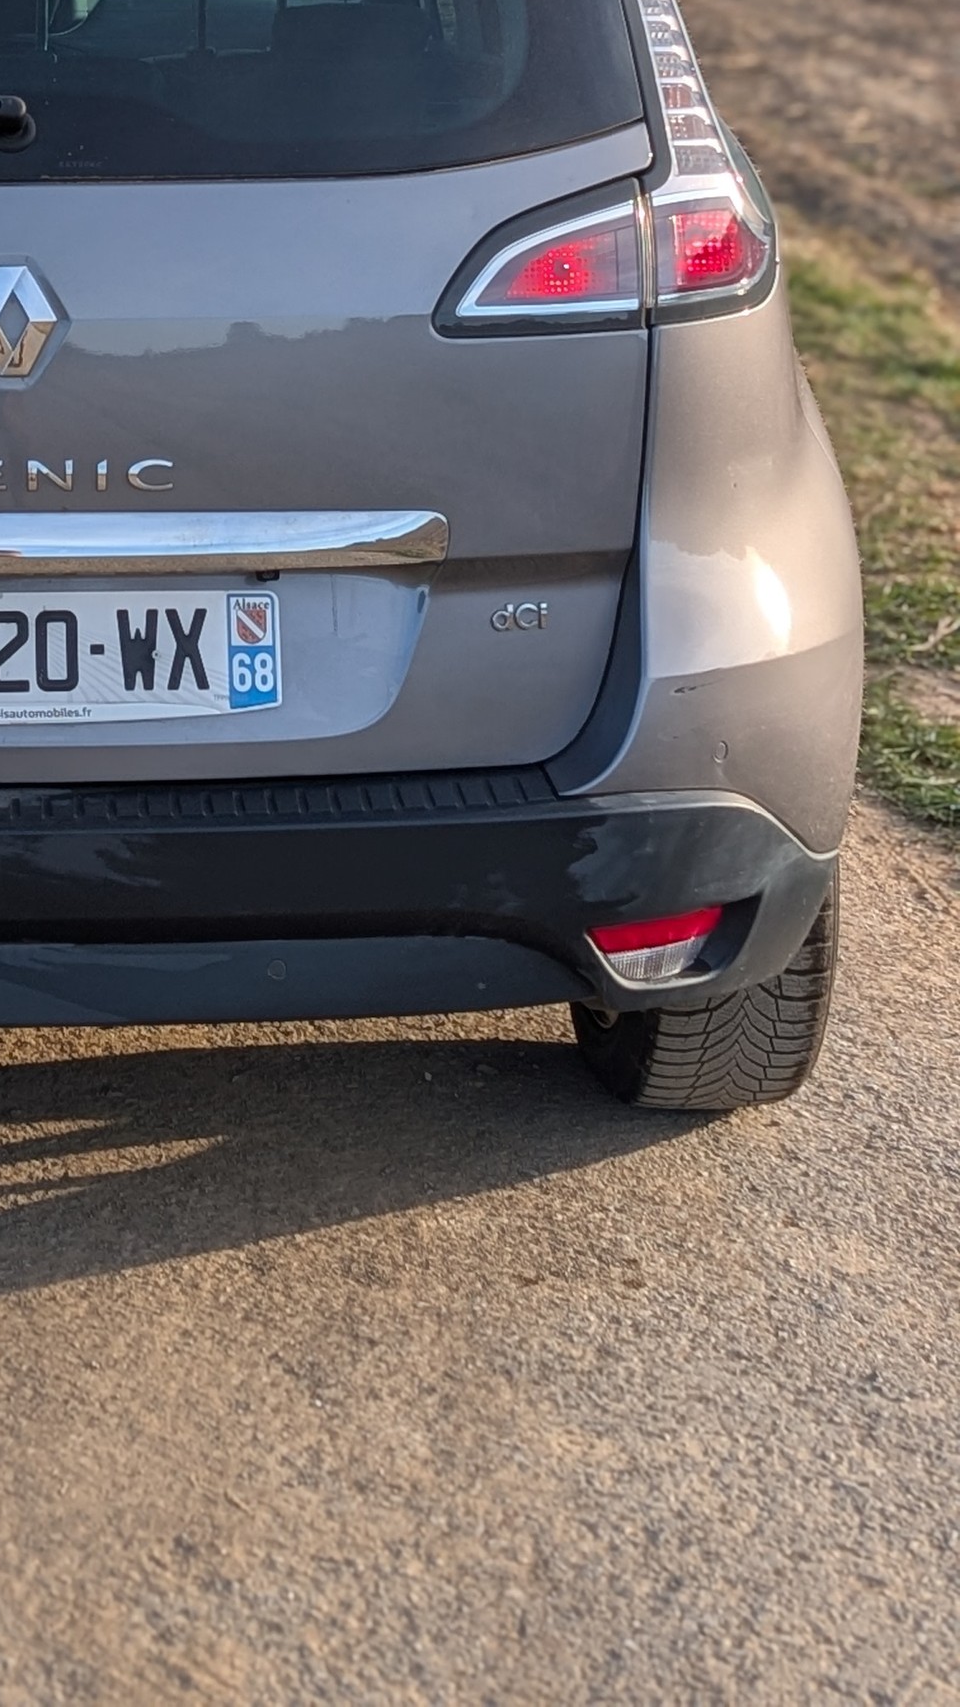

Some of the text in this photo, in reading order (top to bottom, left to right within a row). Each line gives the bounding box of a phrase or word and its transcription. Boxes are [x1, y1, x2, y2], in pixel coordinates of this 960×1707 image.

[233, 598, 270, 610] Alsace
[490, 602, 548, 632] dCi
[232, 652, 275, 693] 68
